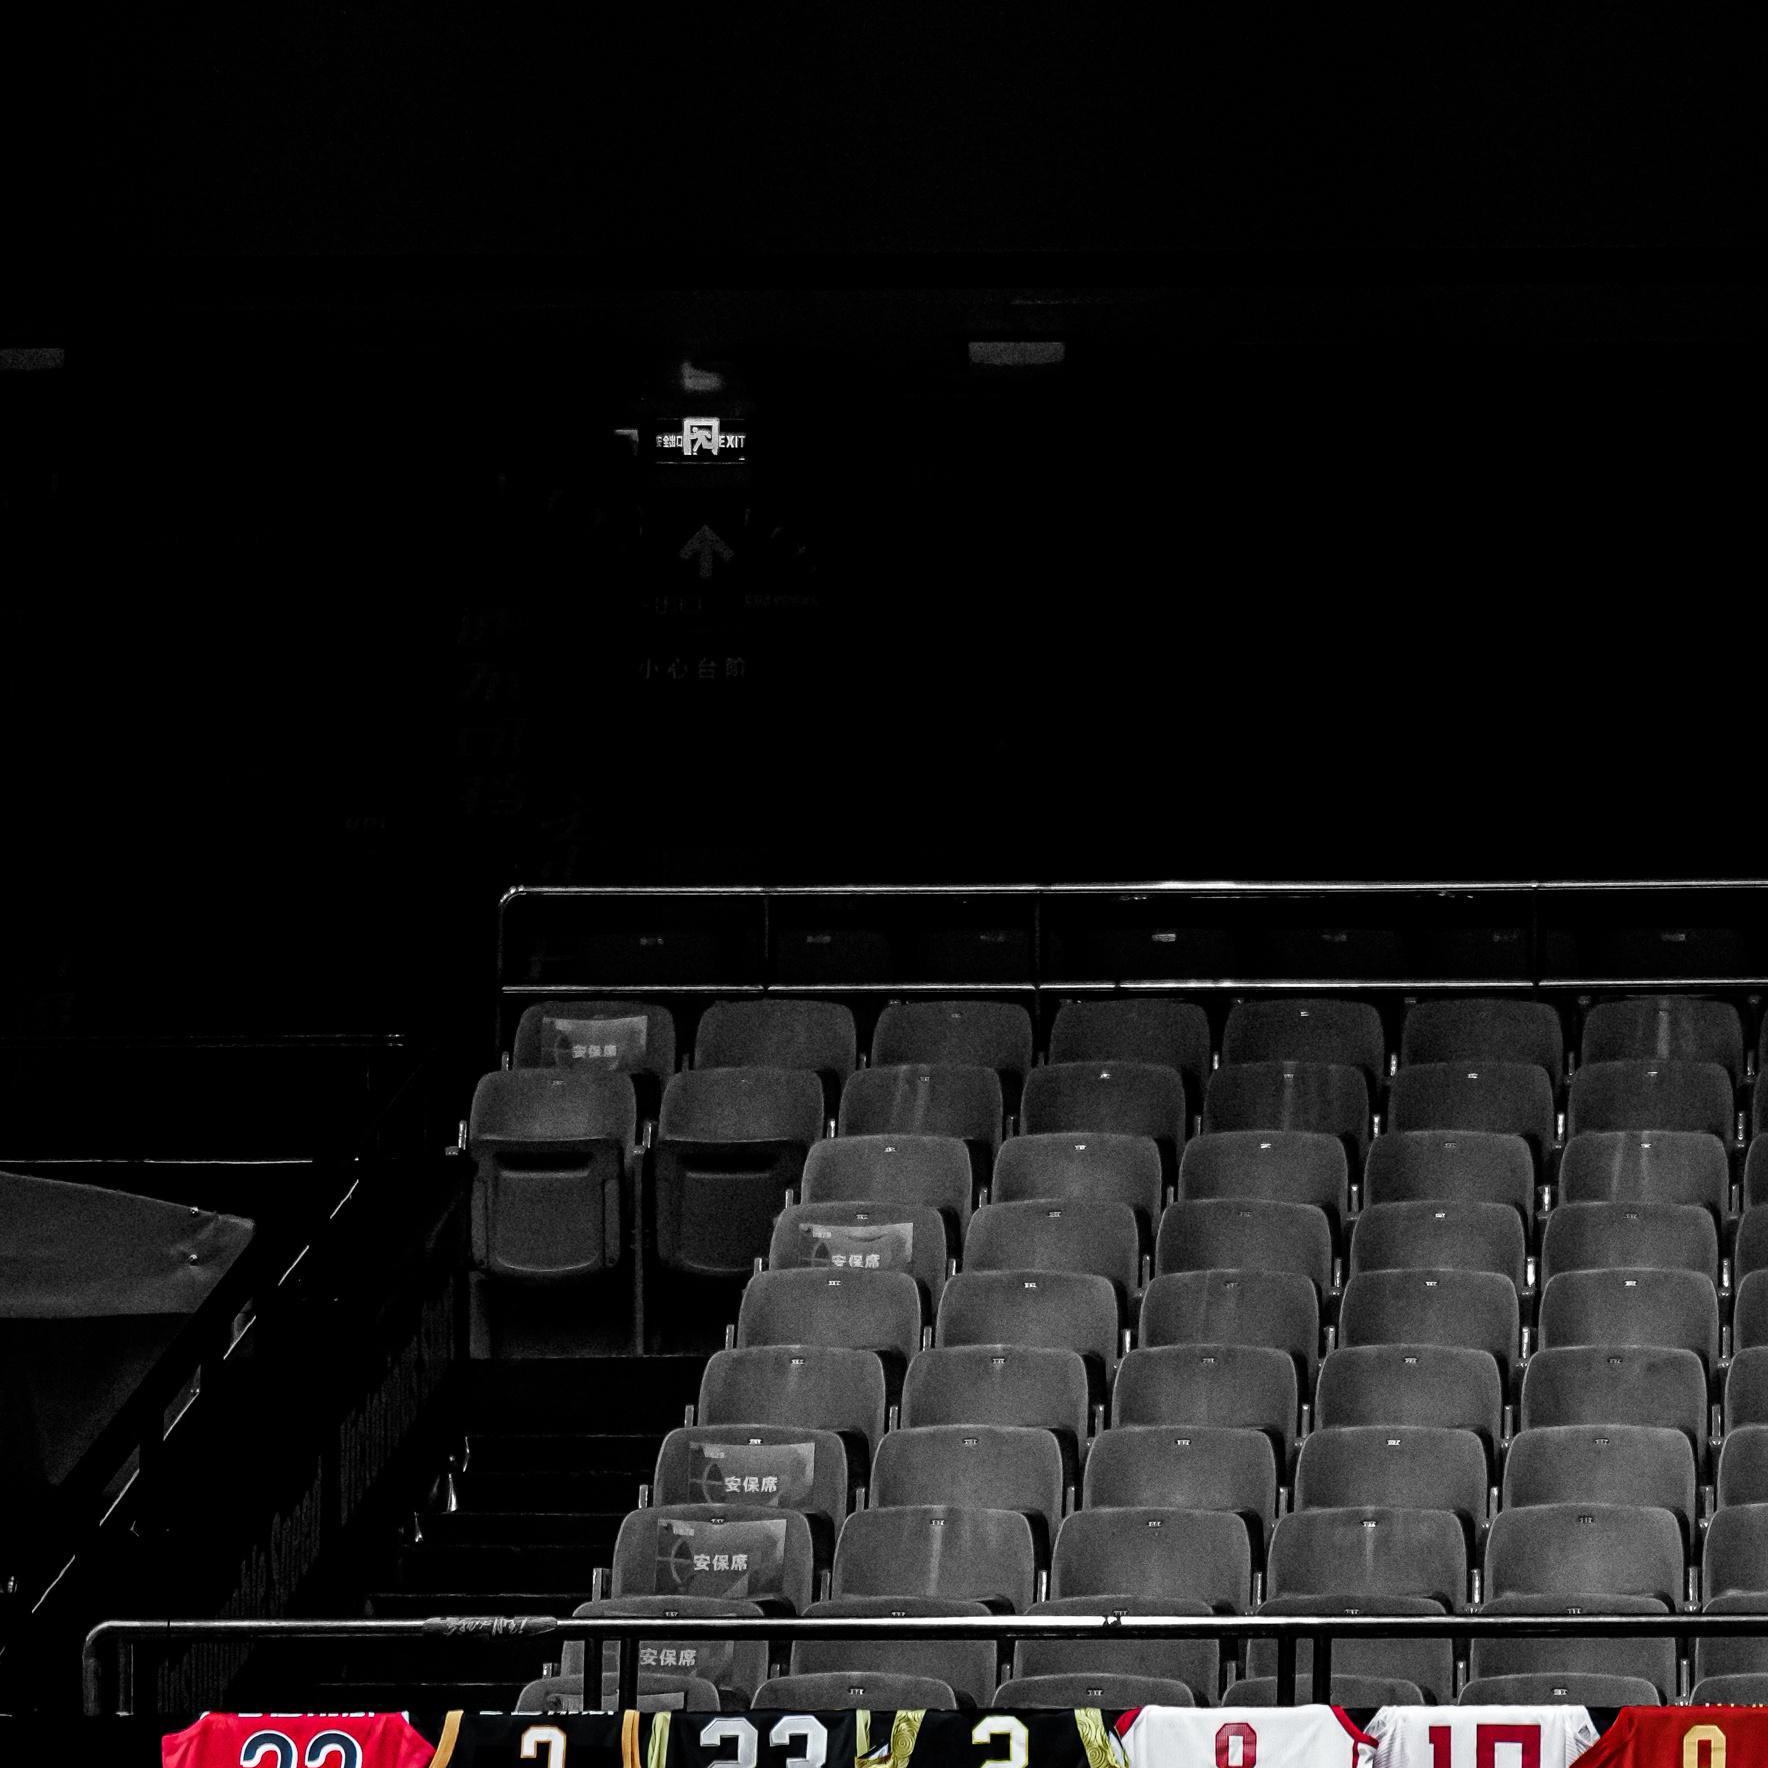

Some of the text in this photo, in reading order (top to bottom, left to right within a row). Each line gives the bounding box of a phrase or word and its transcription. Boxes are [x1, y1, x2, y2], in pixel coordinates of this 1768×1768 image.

[719, 435, 746, 448] EXIT
[724, 1476, 778, 1493] 安保席
[693, 1554, 748, 1571] 安保席
[639, 1648, 697, 1667] 安保席
